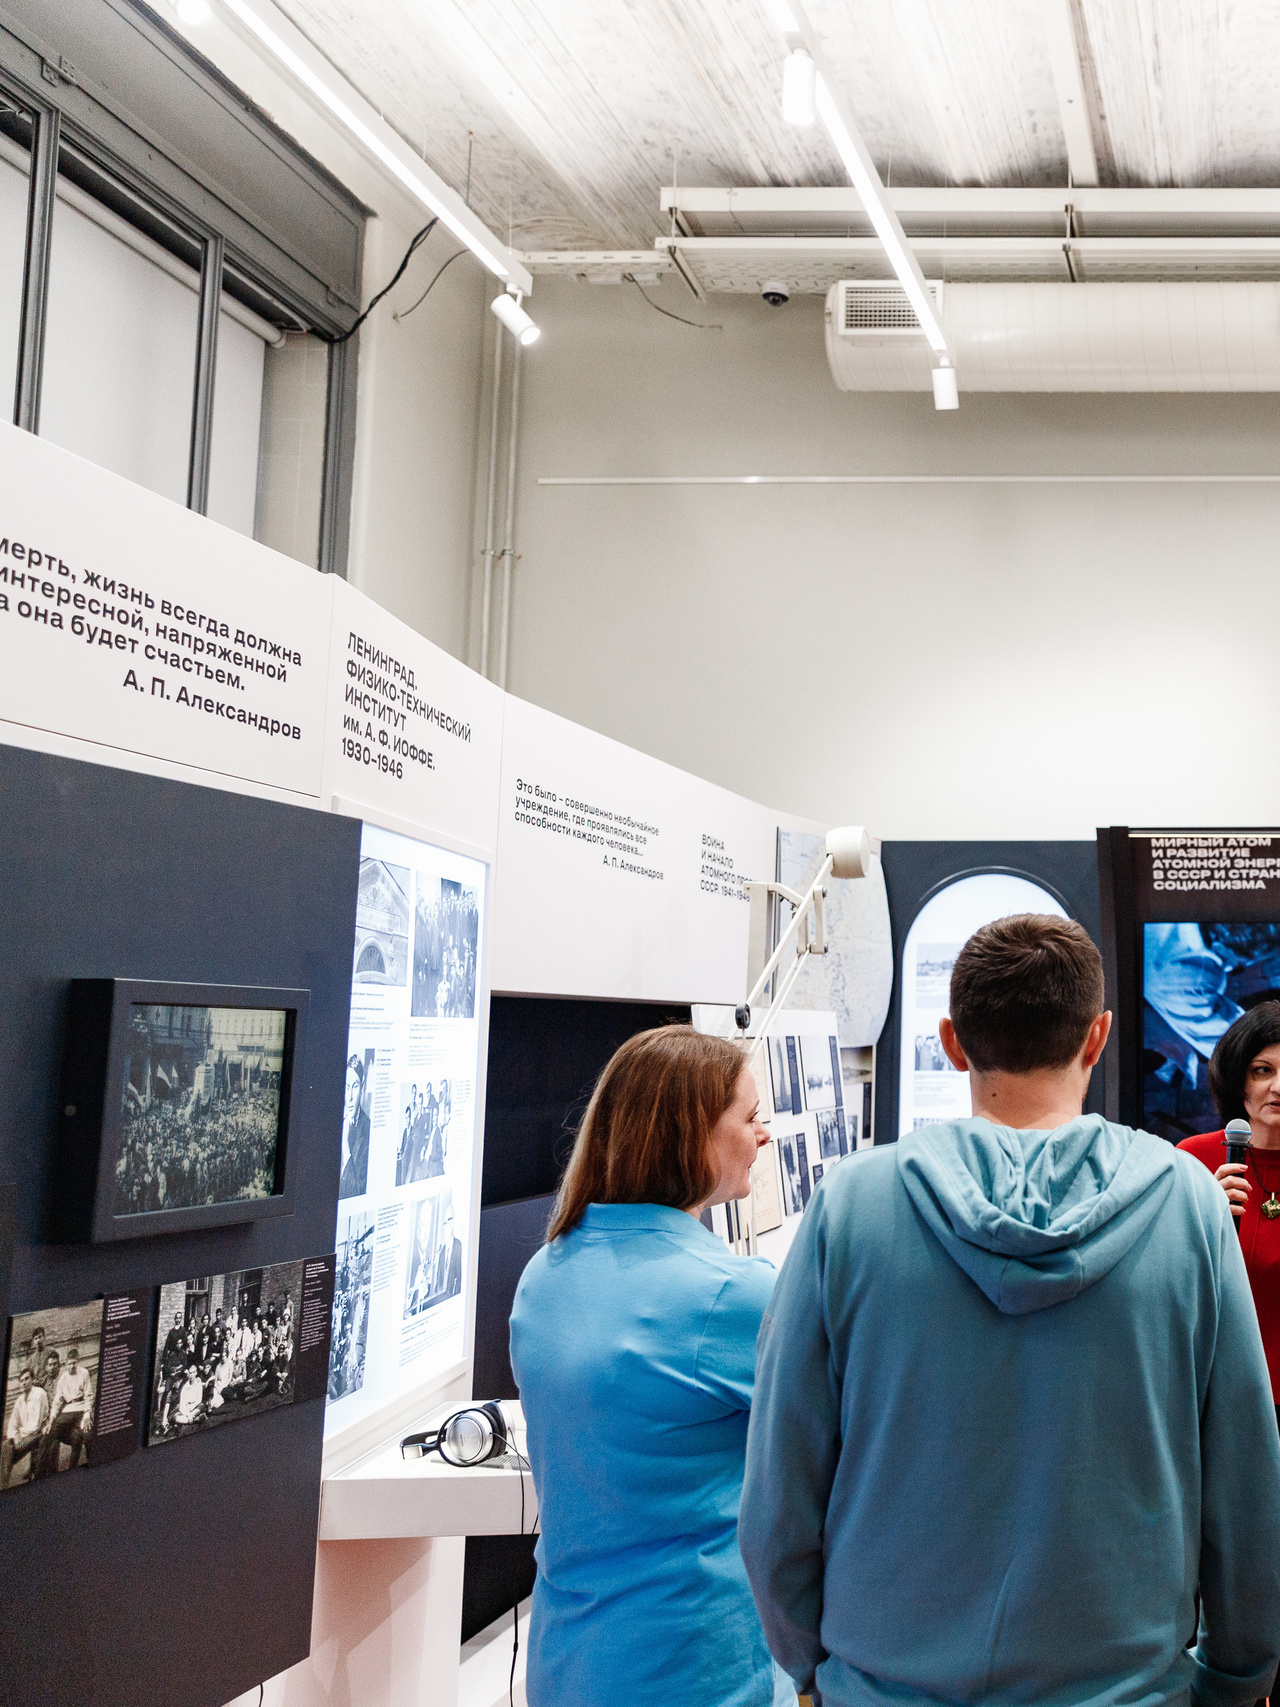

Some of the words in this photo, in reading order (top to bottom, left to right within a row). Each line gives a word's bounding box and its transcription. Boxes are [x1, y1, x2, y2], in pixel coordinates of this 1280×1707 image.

[83, 569, 155, 610] жизнь
[161, 600, 230, 638] всегда
[234, 629, 302, 666] должна
[17, 600, 64, 629] она
[71, 615, 139, 654] будет
[144, 644, 246, 690] счастьем.
[156, 622, 287, 682] напряженной
[348, 632, 417, 691] ЛЕНИНГРАД.
[123, 669, 145, 693] А.
[151, 676, 171, 700] П.
[176, 686, 302, 740] Александров
[345, 683, 406, 731] ИНСТИТУТ
[346, 660, 471, 743] ФИЗИКО-ТЕХНИЧЕСКИЙ
[343, 714, 362, 736] им.
[365, 722, 376, 742] А.
[378, 729, 390, 750] Ф.
[393, 735, 435, 770] ИОФФЕ.
[515, 796, 571, 822] учреждение,
[572, 814, 585, 826] где
[587, 818, 634, 841] проявлялись
[635, 834, 647, 844] все
[515, 811, 571, 836] способности
[572, 829, 604, 845] каждого
[516, 778, 533, 794] Это
[535, 785, 557, 802] было
[565, 797, 613, 821] совершенно
[614, 814, 659, 836] необычайное
[1151, 838, 1224, 847] МИРНЫЙ
[1226, 838, 1271, 846] АТОМ
[1152, 849, 1163, 858] И
[1166, 848, 1250, 858] РАЗВИТИЕ
[1152, 856, 1231, 869] АТОМНОЙ
[603, 855, 610, 866] А.
[612, 857, 619, 868] П.
[620, 860, 664, 880] Александров
[1153, 870, 1164, 879] В
[1167, 870, 1211, 879] СССР
[1214, 869, 1225, 879] И
[1153, 880, 1266, 891] СОЦИАЛИЗМА
